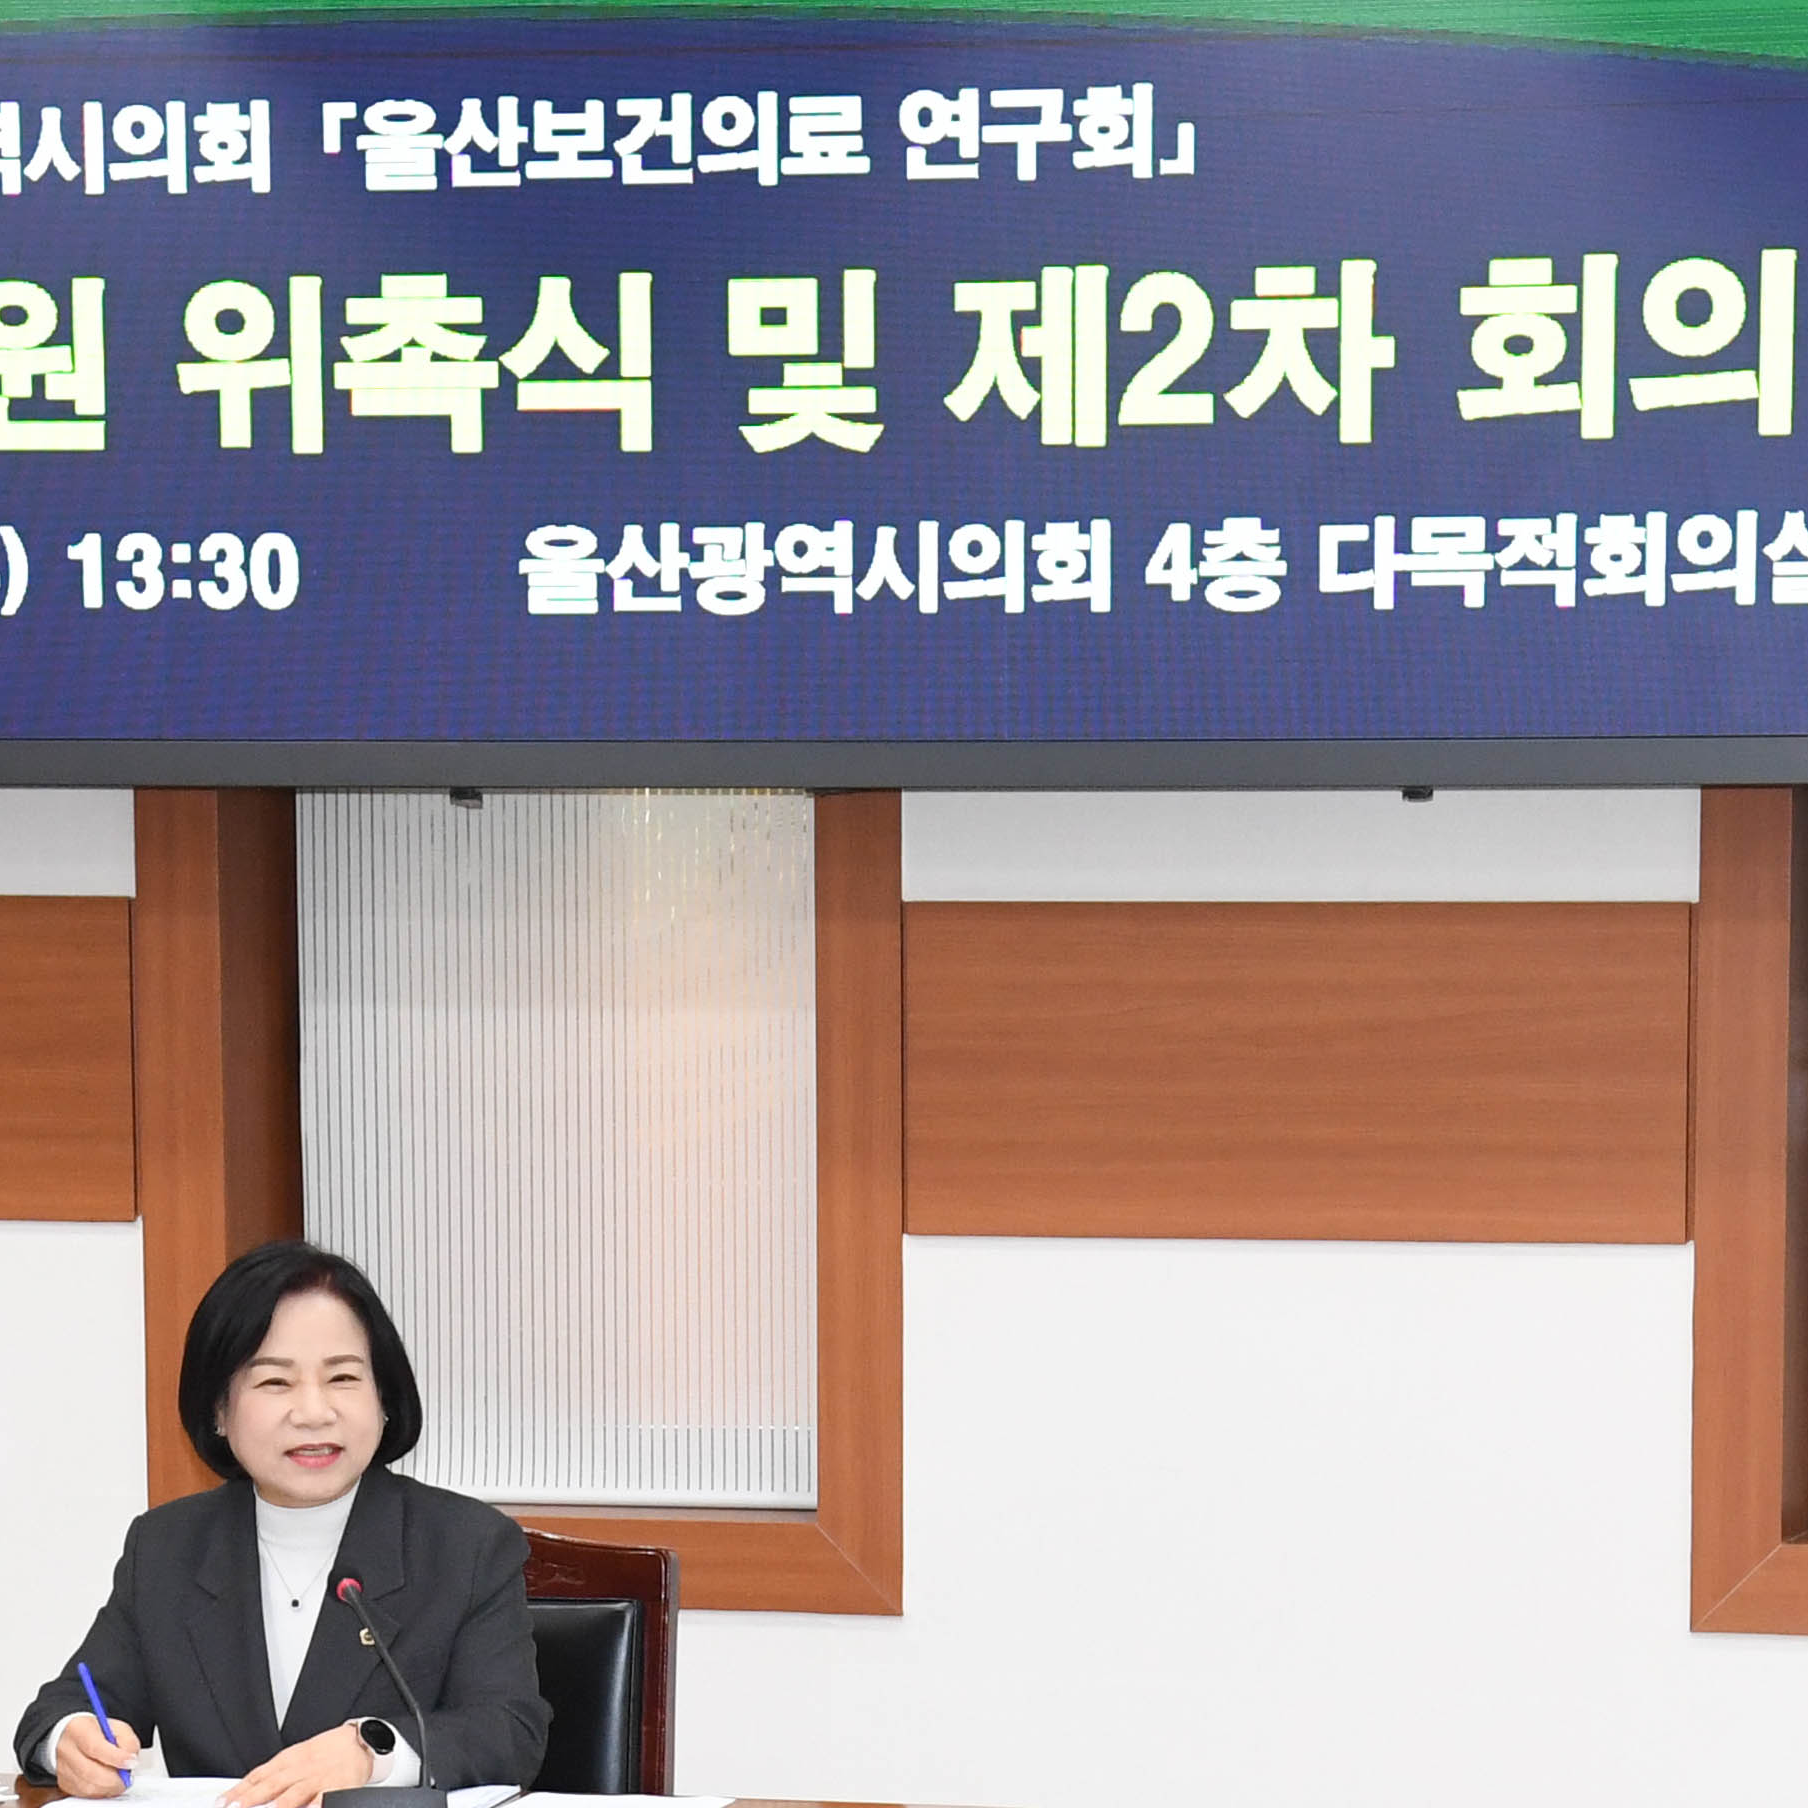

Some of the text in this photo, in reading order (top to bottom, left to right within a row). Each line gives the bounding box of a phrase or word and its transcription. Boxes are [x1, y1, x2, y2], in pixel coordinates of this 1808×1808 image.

[322, 90, 871, 191] 「울산보건의료
[898, 82, 1195, 182] 연구회」
[176, 272, 653, 455] 위촉식
[727, 269, 884, 453] 및
[943, 259, 1396, 447] 제2차
[1456, 248, 1797, 440] 회의
[67, 532, 300, 611] 13:30
[518, 518, 1112, 616] 울산광역시의회
[1144, 517, 1288, 613] 4층
